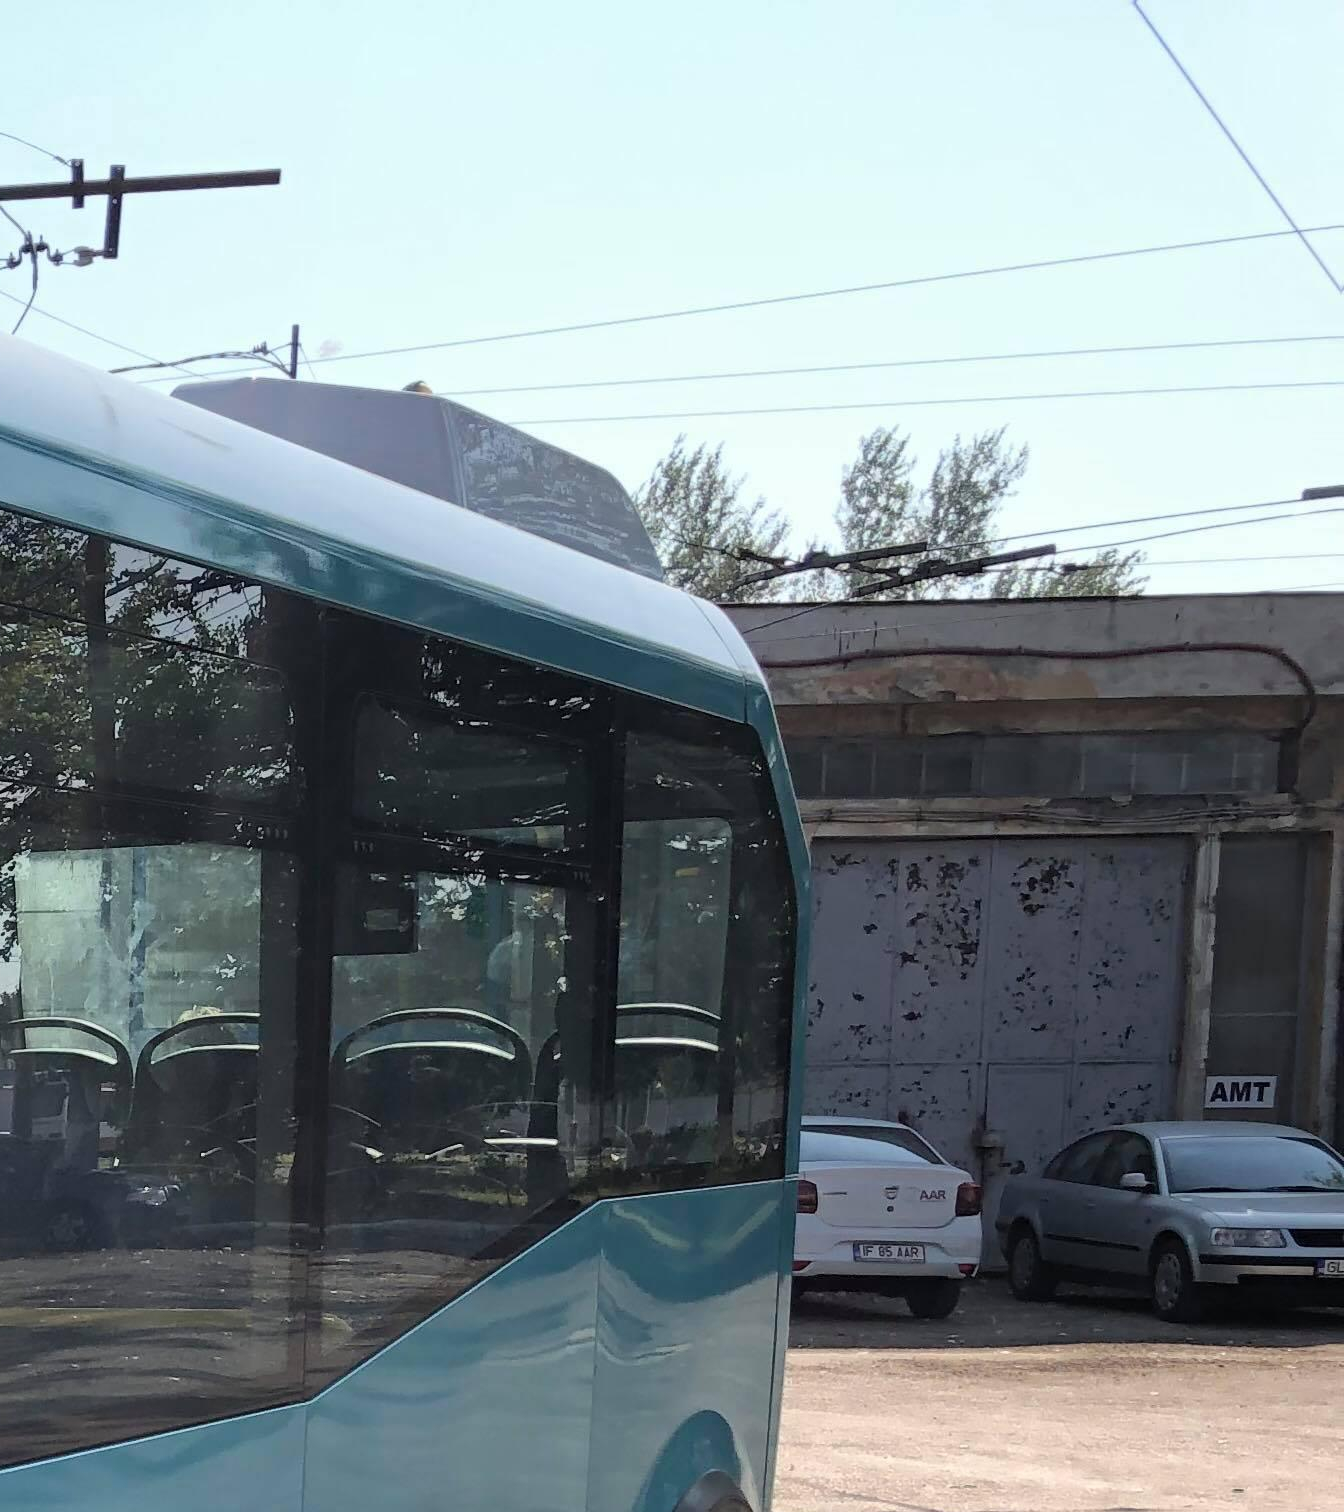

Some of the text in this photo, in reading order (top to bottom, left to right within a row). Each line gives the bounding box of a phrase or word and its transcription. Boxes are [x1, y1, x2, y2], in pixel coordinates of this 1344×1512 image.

[1210, 1081, 1271, 1103] AMT
[920, 1189, 946, 1201] AAR
[862, 1245, 874, 1257] IF
[897, 1246, 919, 1258] AAR
